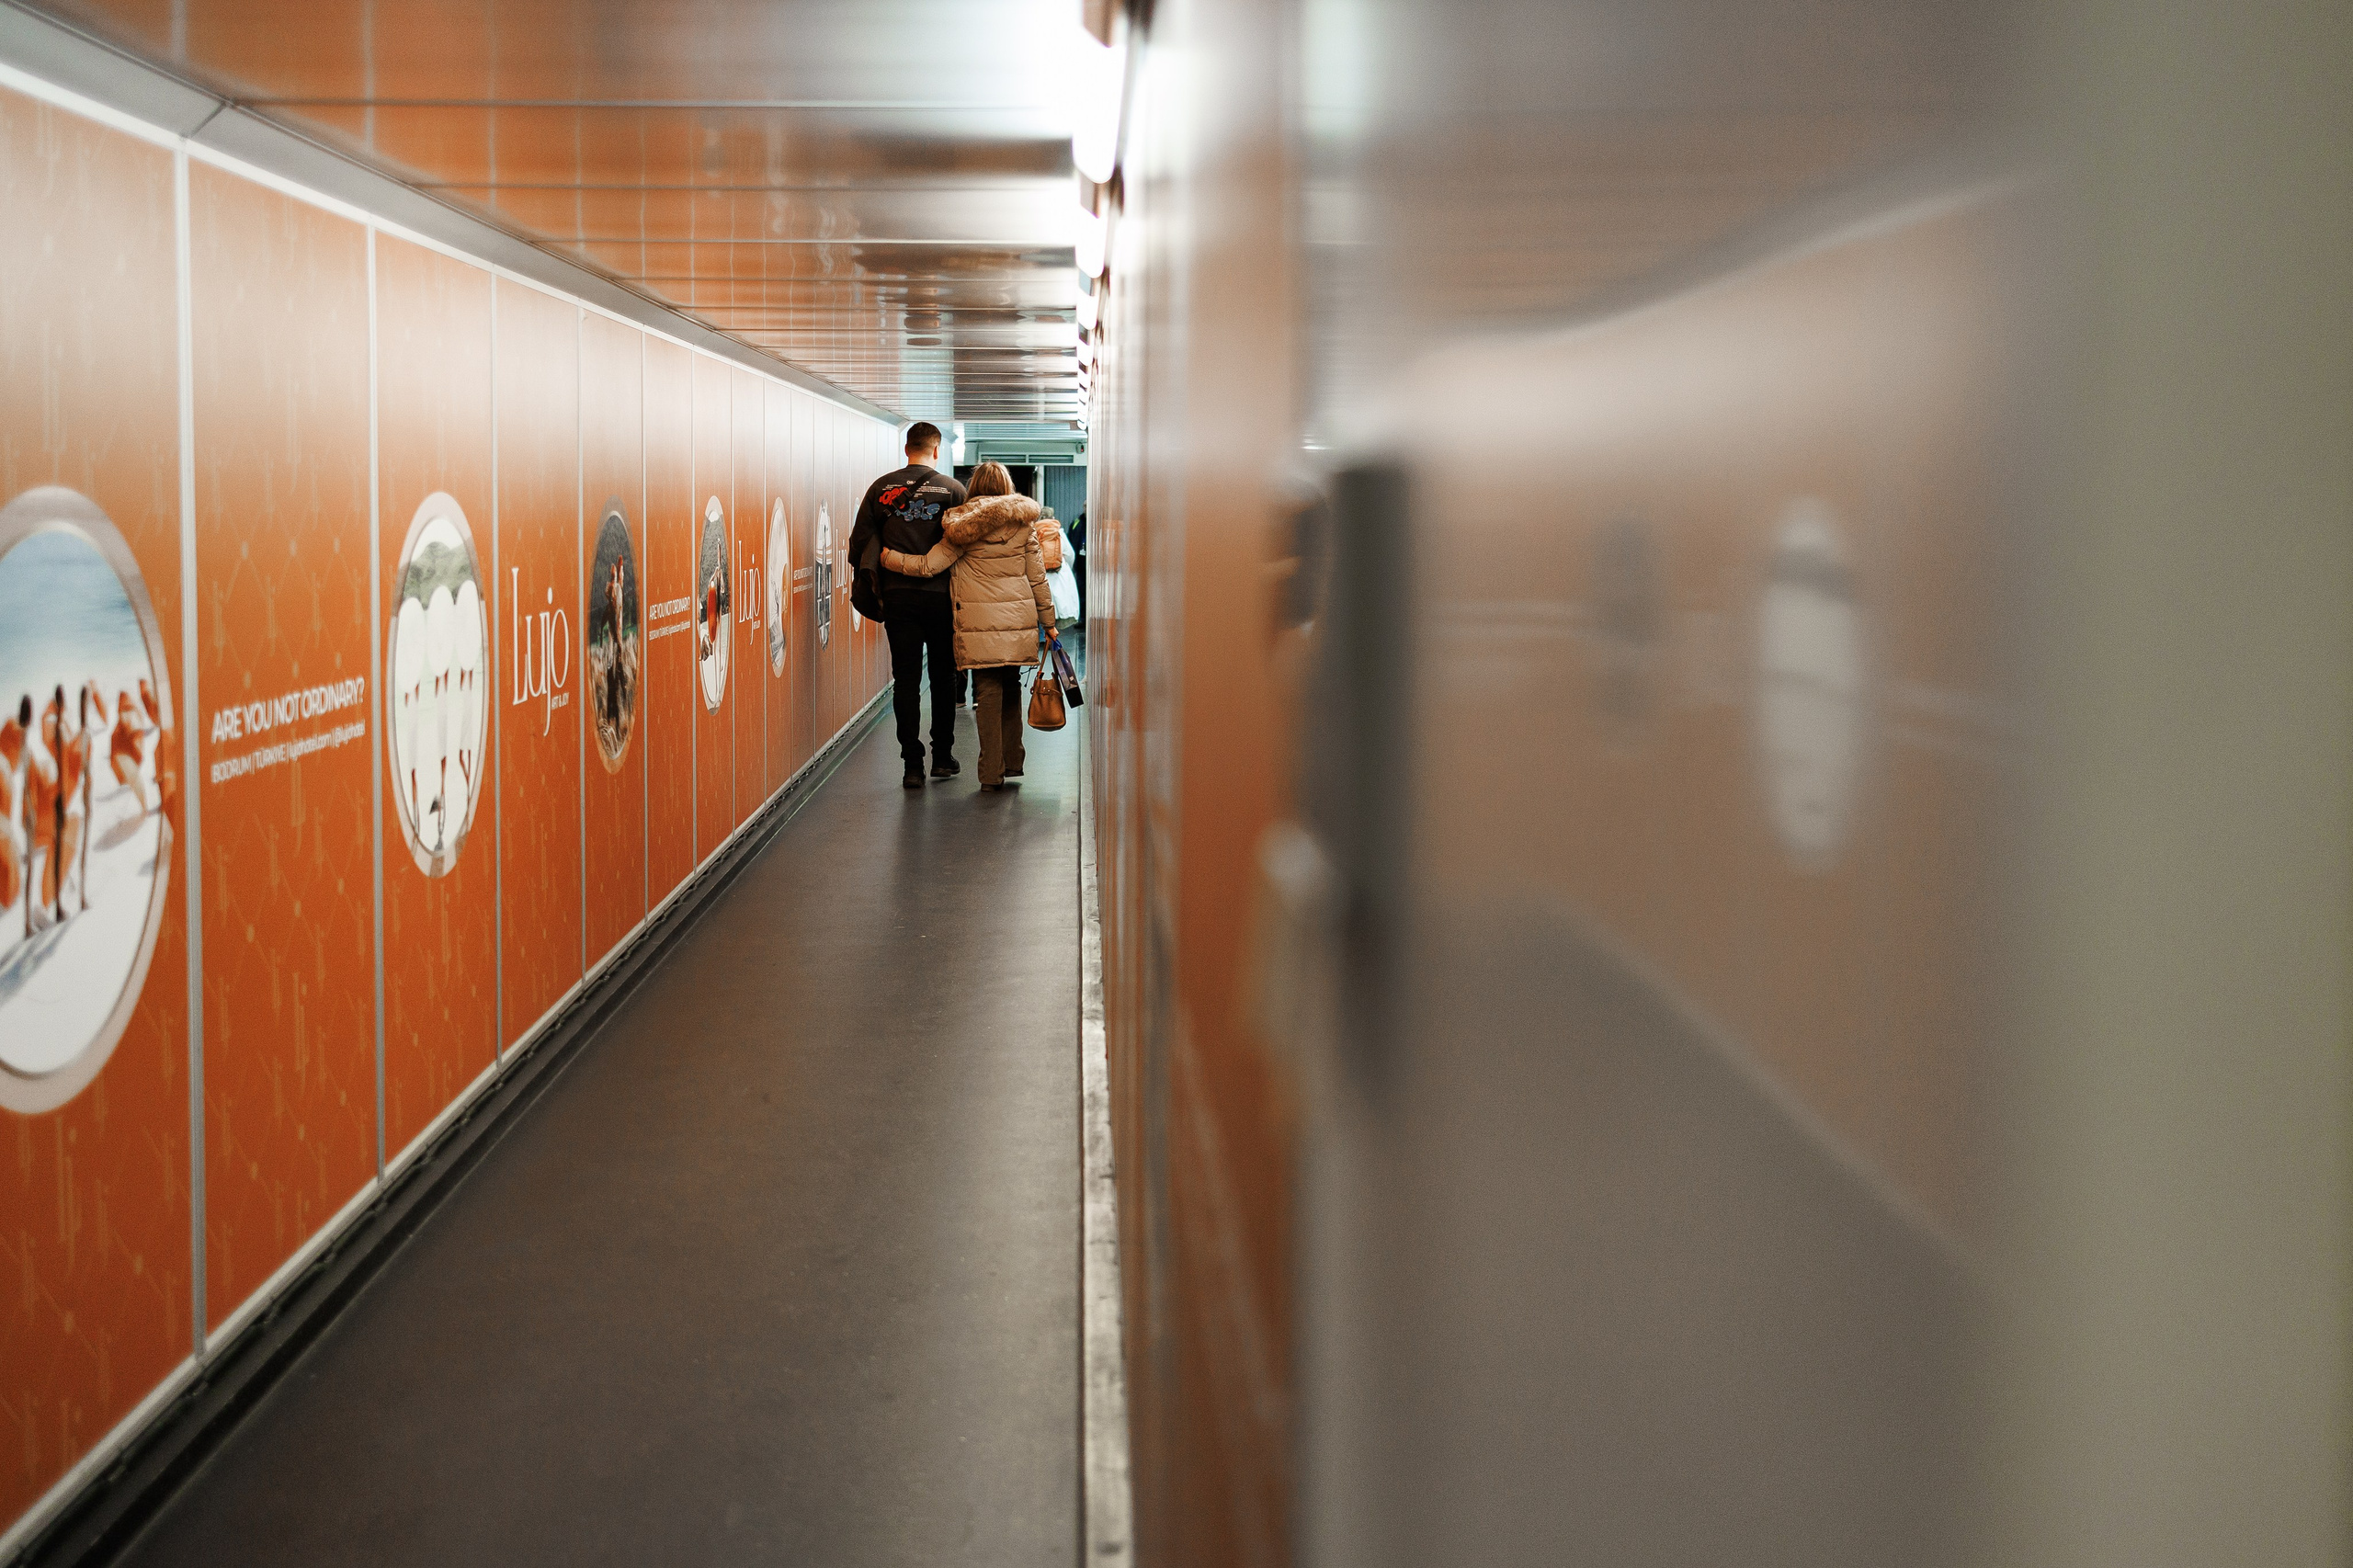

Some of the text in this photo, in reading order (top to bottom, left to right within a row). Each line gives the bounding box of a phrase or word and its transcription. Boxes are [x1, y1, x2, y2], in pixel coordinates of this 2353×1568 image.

[738, 540, 761, 645] Lujo
[511, 567, 569, 736] Lujo
[211, 676, 365, 744] ARE YOU NOT ORDINARY?
[211, 756, 251, 783] BODRUM
